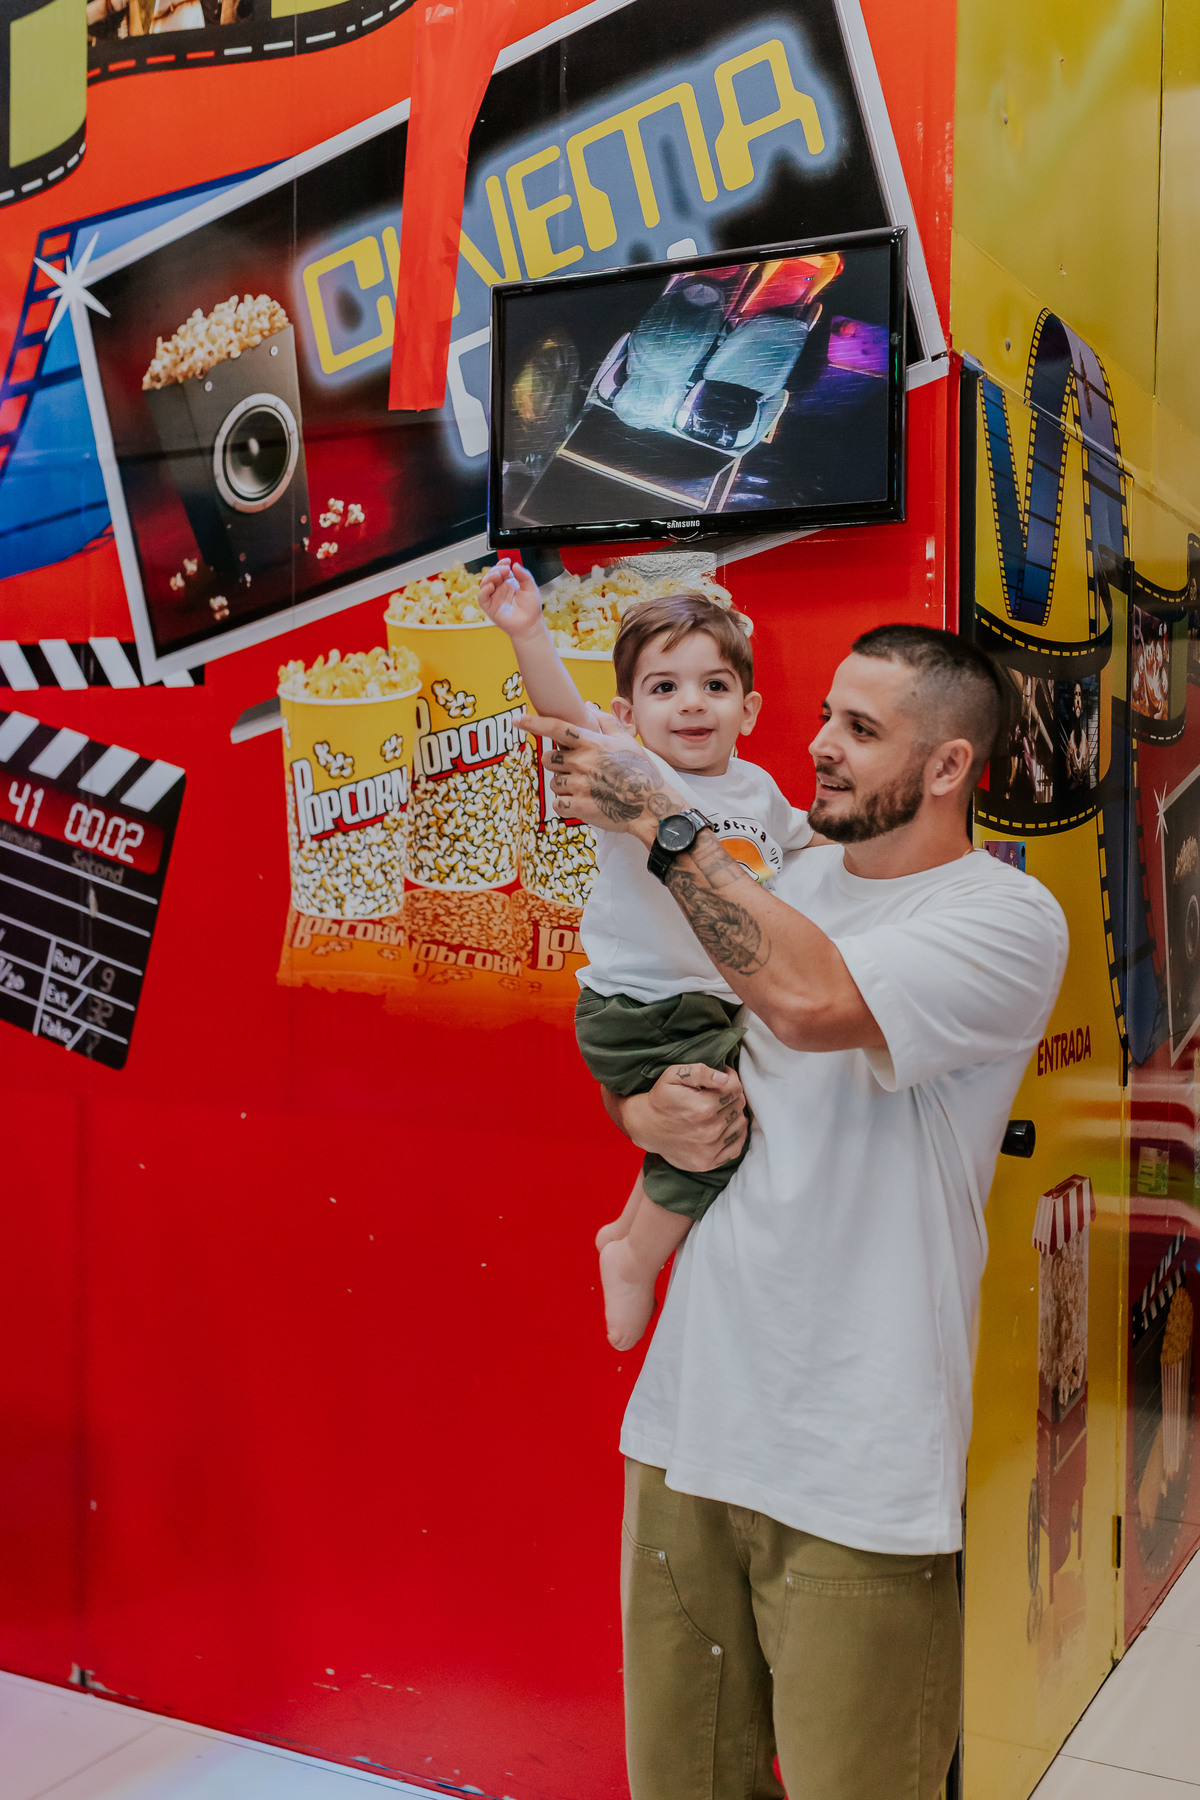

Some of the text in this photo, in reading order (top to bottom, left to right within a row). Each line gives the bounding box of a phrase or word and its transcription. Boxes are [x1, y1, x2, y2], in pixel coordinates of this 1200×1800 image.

[666, 519, 701, 529] SAMSUNG
[8, 780, 45, 828] 41
[291, 757, 408, 841] POPCORN
[100, 966, 116, 993] 9
[86, 997, 115, 1028] 32
[1037, 1025, 1092, 1077] ENTRADA
